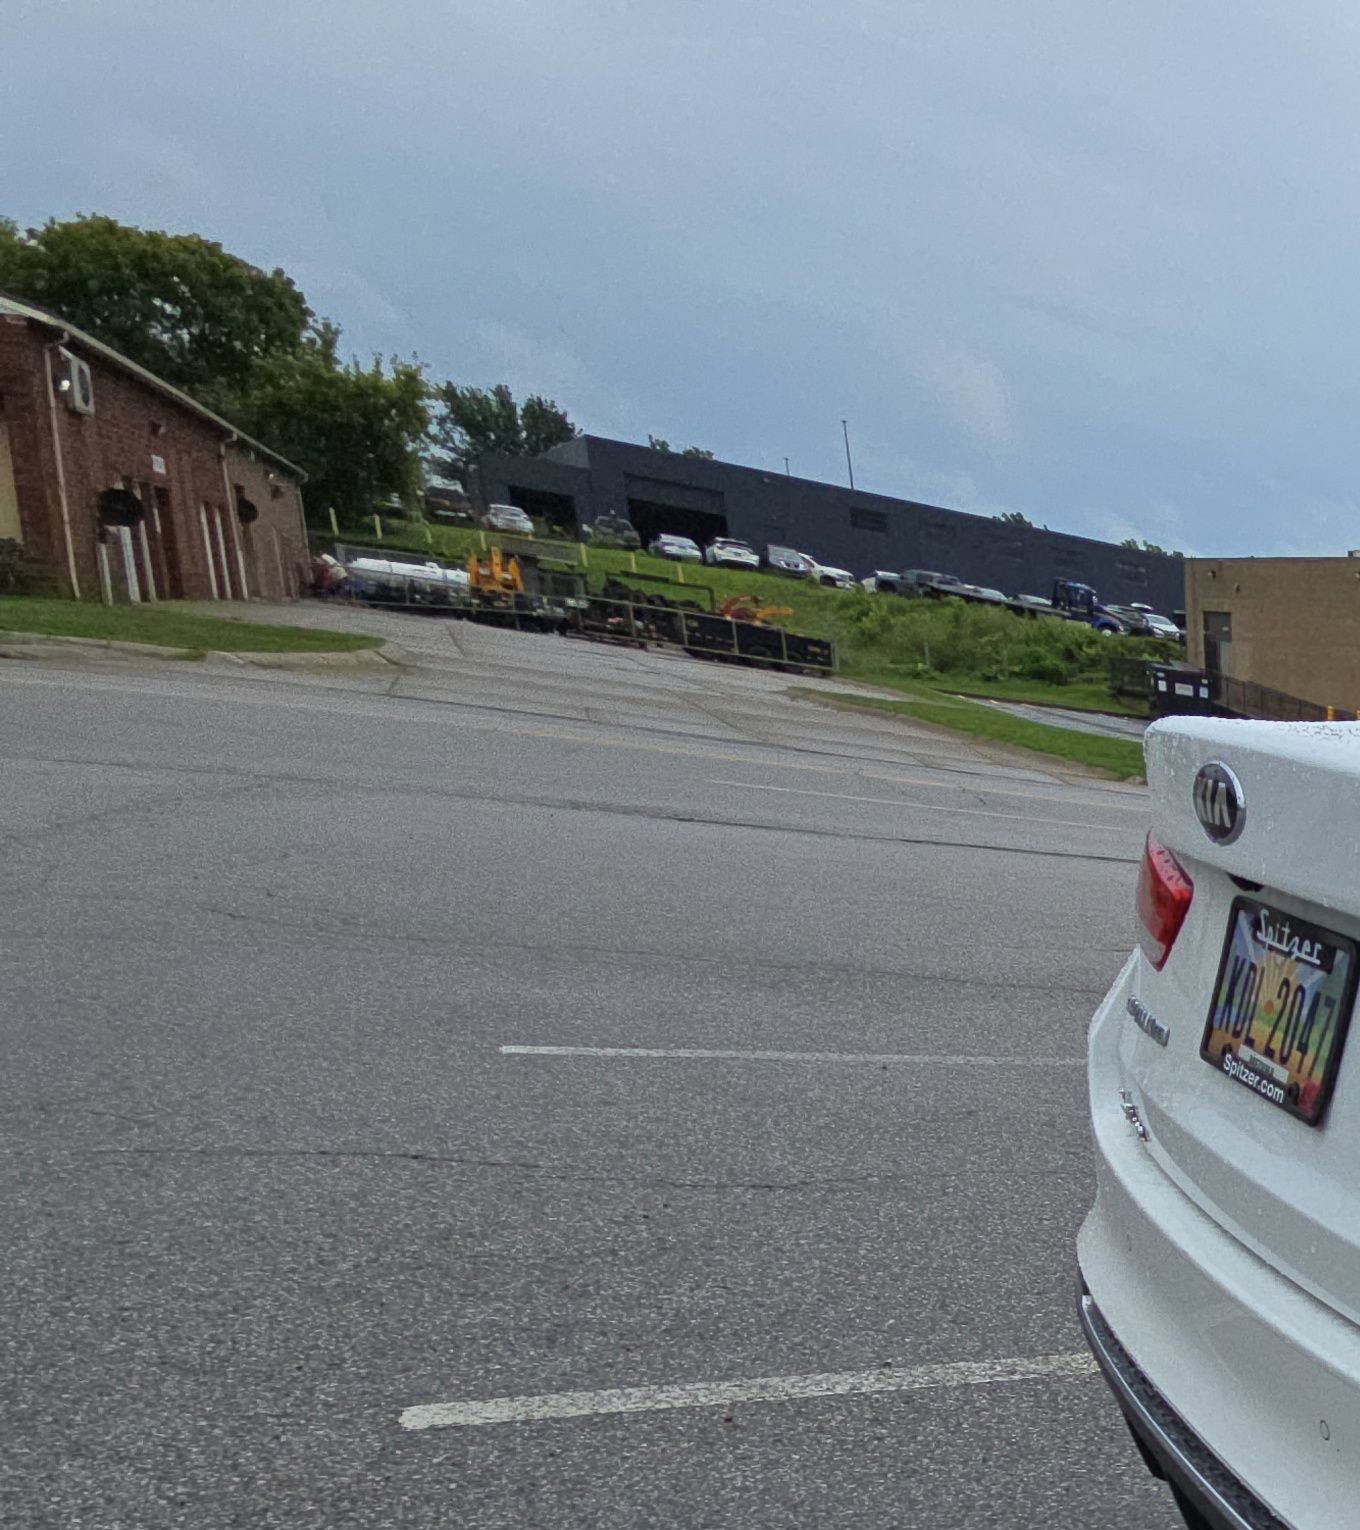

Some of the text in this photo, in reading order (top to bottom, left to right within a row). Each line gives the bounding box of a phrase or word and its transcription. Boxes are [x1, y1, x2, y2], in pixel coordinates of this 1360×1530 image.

[1195, 776, 1232, 828] KIA
[1256, 908, 1322, 965] Spitzer
[1218, 955, 1265, 1049] KDL
[1265, 977, 1337, 1079] 2047
[1223, 1053, 1285, 1103] Spitzer.com
